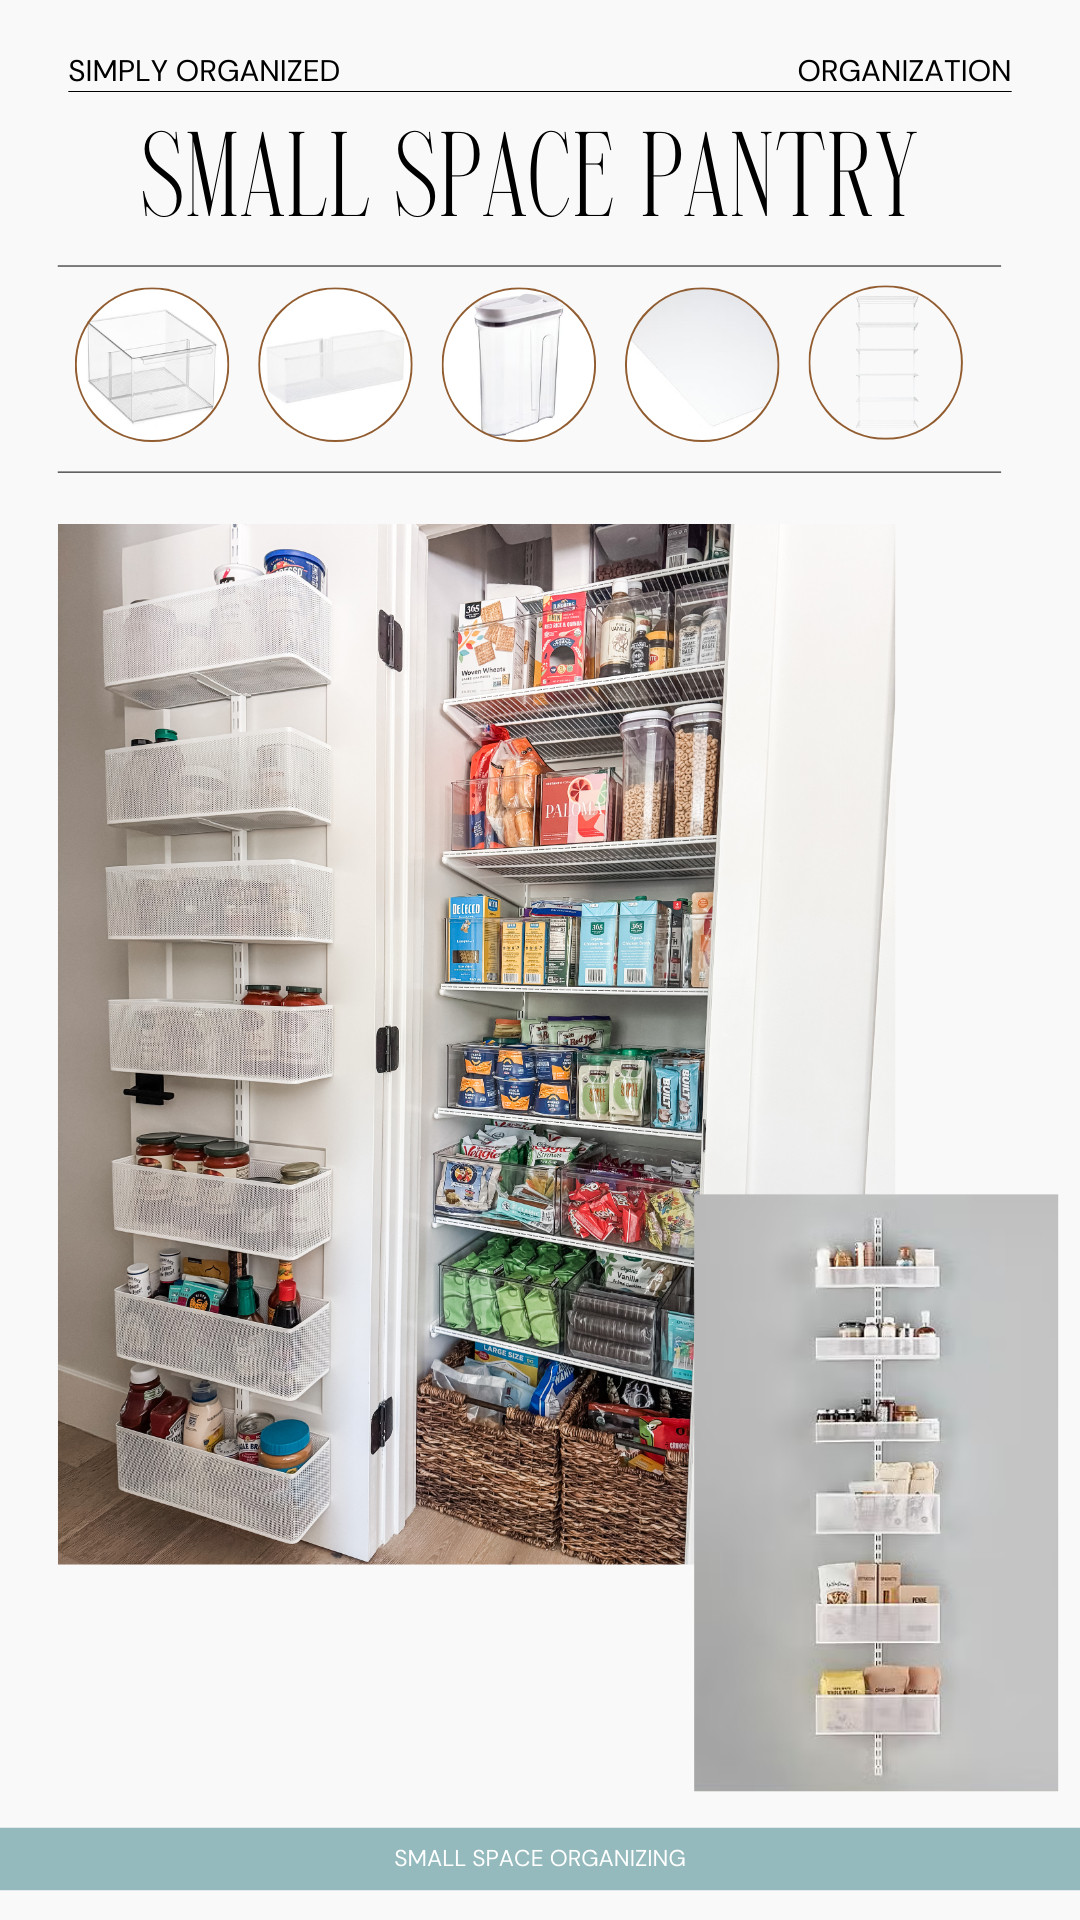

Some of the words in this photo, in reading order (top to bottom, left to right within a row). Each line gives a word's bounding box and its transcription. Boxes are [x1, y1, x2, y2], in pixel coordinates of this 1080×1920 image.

[465, 604, 480, 614] 365
[461, 668, 481, 676] Woven
[483, 666, 506, 674] Wheats
[545, 800, 604, 818] PALOMA
[681, 1069, 691, 1101] BUILT
[661, 1077, 671, 1110] BUILT
[463, 1145, 500, 1160] Veggie
[617, 1272, 639, 1283] Vanilla
[620, 1266, 638, 1274] Organic
[483, 1344, 507, 1357] LARGE
[508, 1351, 524, 1362] SIZE
